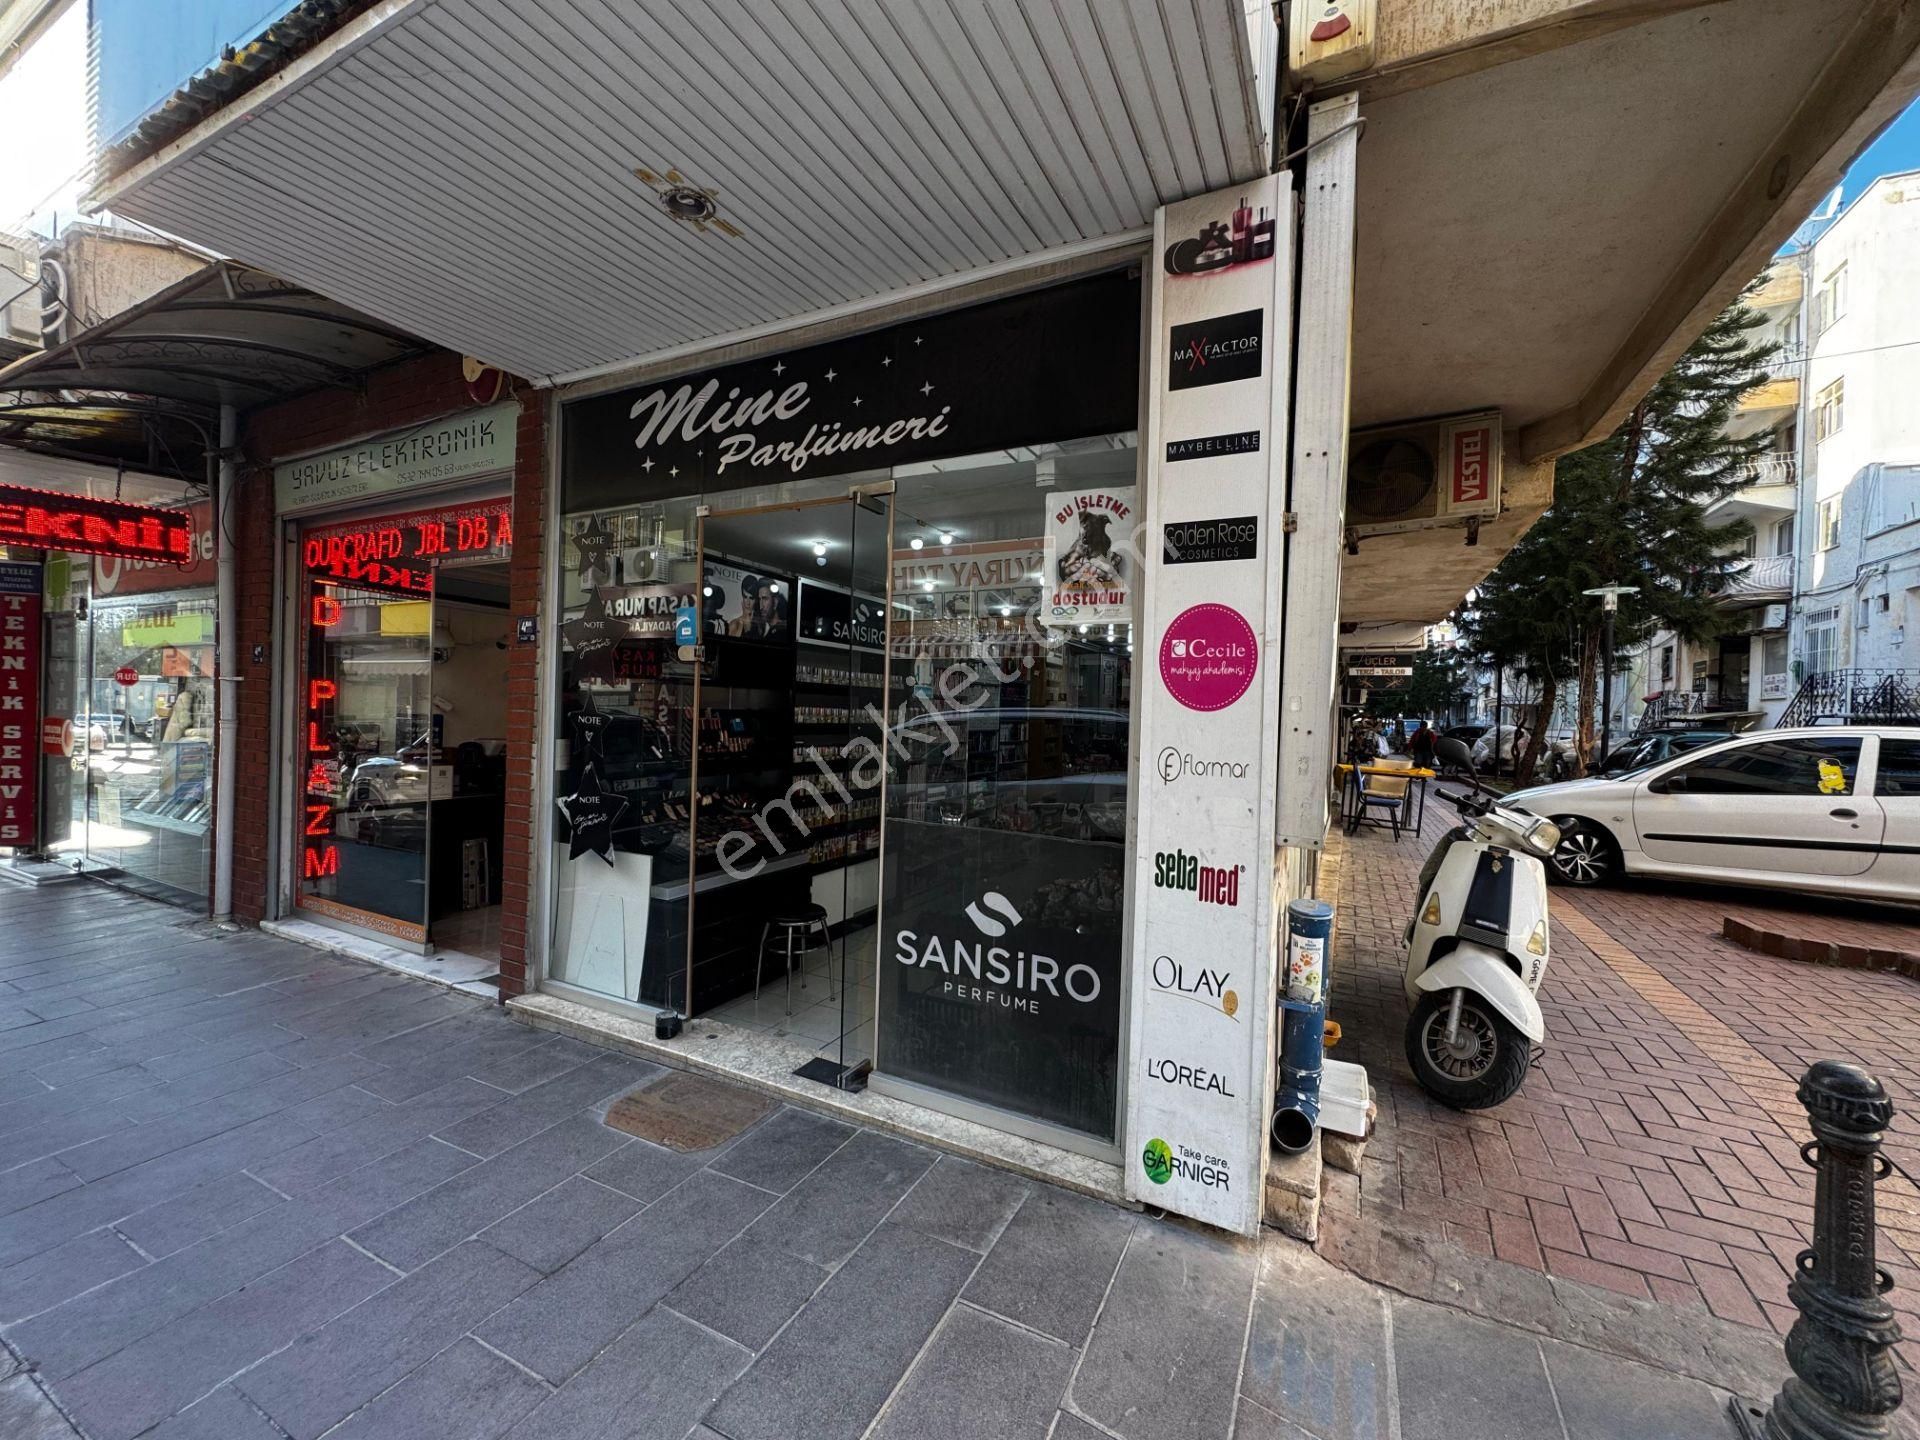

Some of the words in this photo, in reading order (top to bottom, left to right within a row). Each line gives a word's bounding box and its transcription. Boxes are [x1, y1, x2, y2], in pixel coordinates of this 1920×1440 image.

[630, 378, 811, 449] Mine
[716, 406, 951, 475] Parfümeri
[1168, 434, 1259, 455] MAYBELLINE
[291, 456, 350, 490] YAVUZ
[1461, 430, 1481, 500] VESTEL
[1056, 504, 1073, 524] BU
[414, 522, 451, 556] JBL
[457, 515, 489, 551] DB
[582, 536, 606, 545] NOTE
[1164, 523, 1215, 547] Golden
[1218, 522, 1256, 543] Rose
[1178, 546, 1239, 561] COSMETICS
[714, 566, 742, 580] NOTE
[1052, 588, 1127, 605] dostudur
[584, 621, 605, 629] NOTE
[1189, 639, 1246, 658] Cecile
[1171, 661, 1201, 681] makyaj
[578, 715, 601, 725] NOTE
[1183, 753, 1249, 779] flormar
[579, 796, 601, 804] NOTE
[1153, 955, 1230, 998] OLAY
[944, 981, 1041, 1014] PERFUME
[1178, 1144, 1202, 1161] Take
[1204, 1154, 1231, 1170] care.
